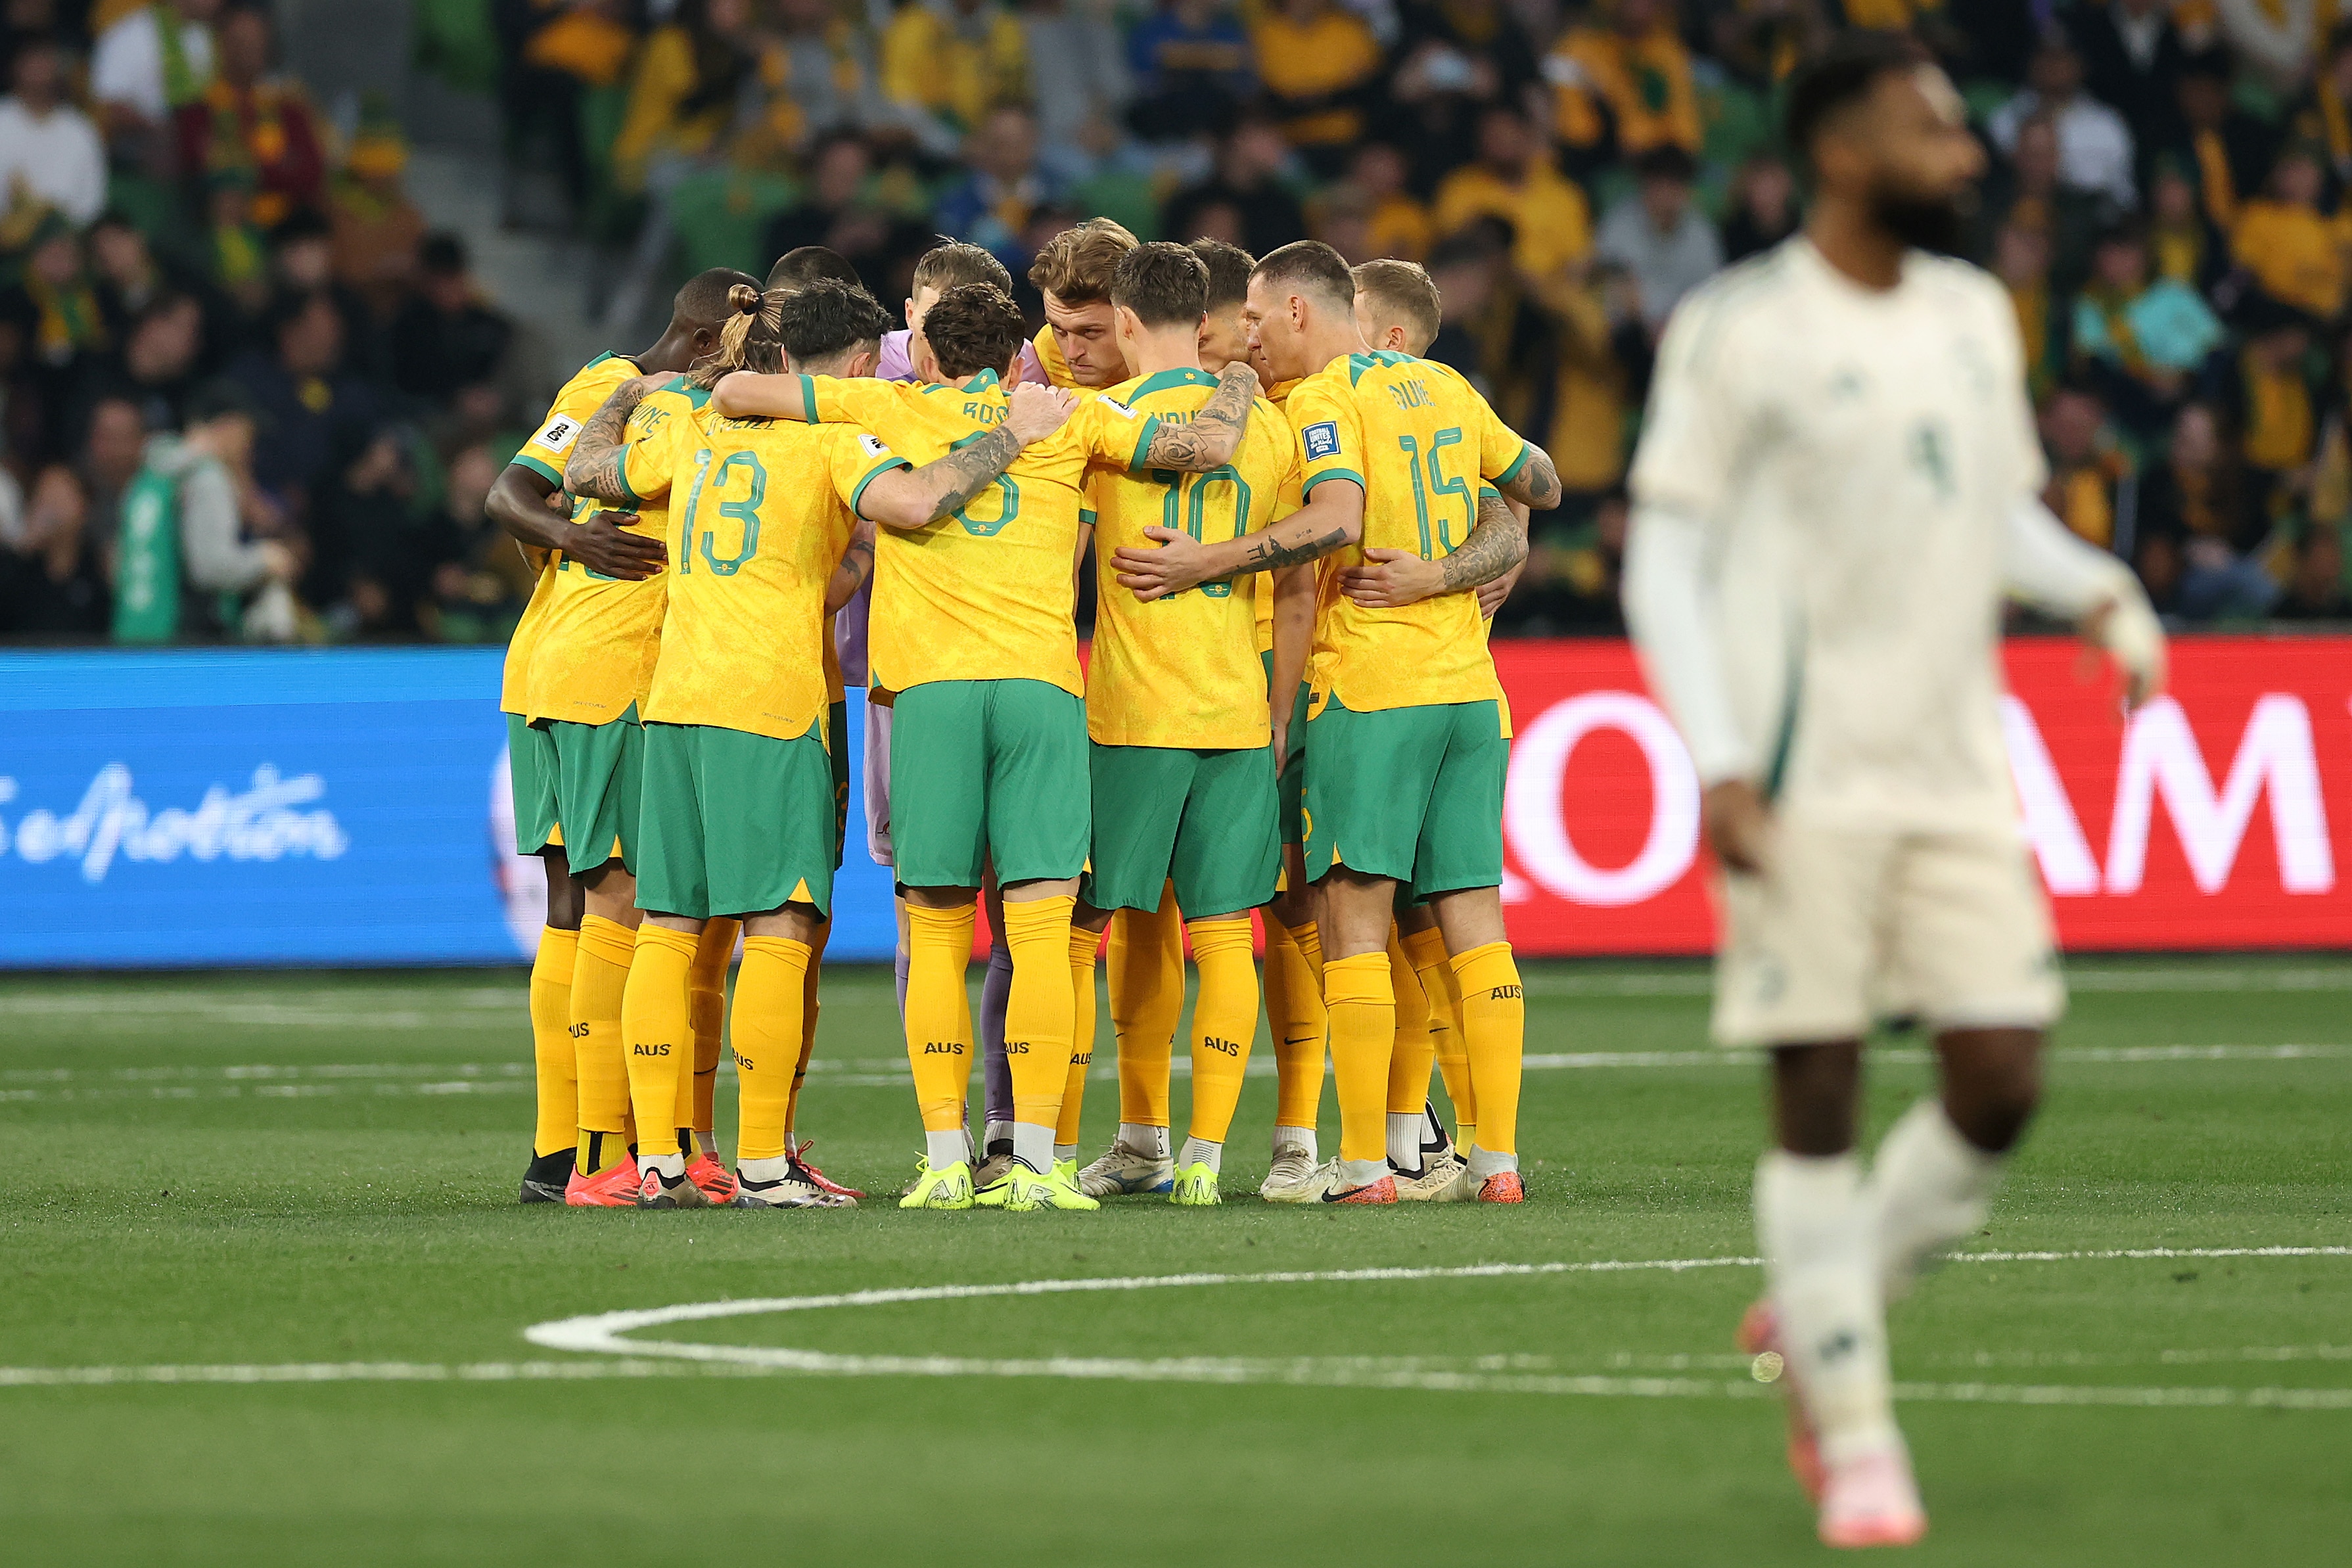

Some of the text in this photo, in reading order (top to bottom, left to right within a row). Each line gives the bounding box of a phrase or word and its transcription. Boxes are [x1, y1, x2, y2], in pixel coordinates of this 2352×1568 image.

[1398, 427, 1475, 561] 15
[680, 448, 767, 576] 13
[1152, 464, 1251, 600] 10
[1491, 985, 1521, 1000] AUS
[634, 1043, 672, 1055] AUS
[924, 1042, 965, 1055] AUS
[1205, 1036, 1239, 1057] AUS
